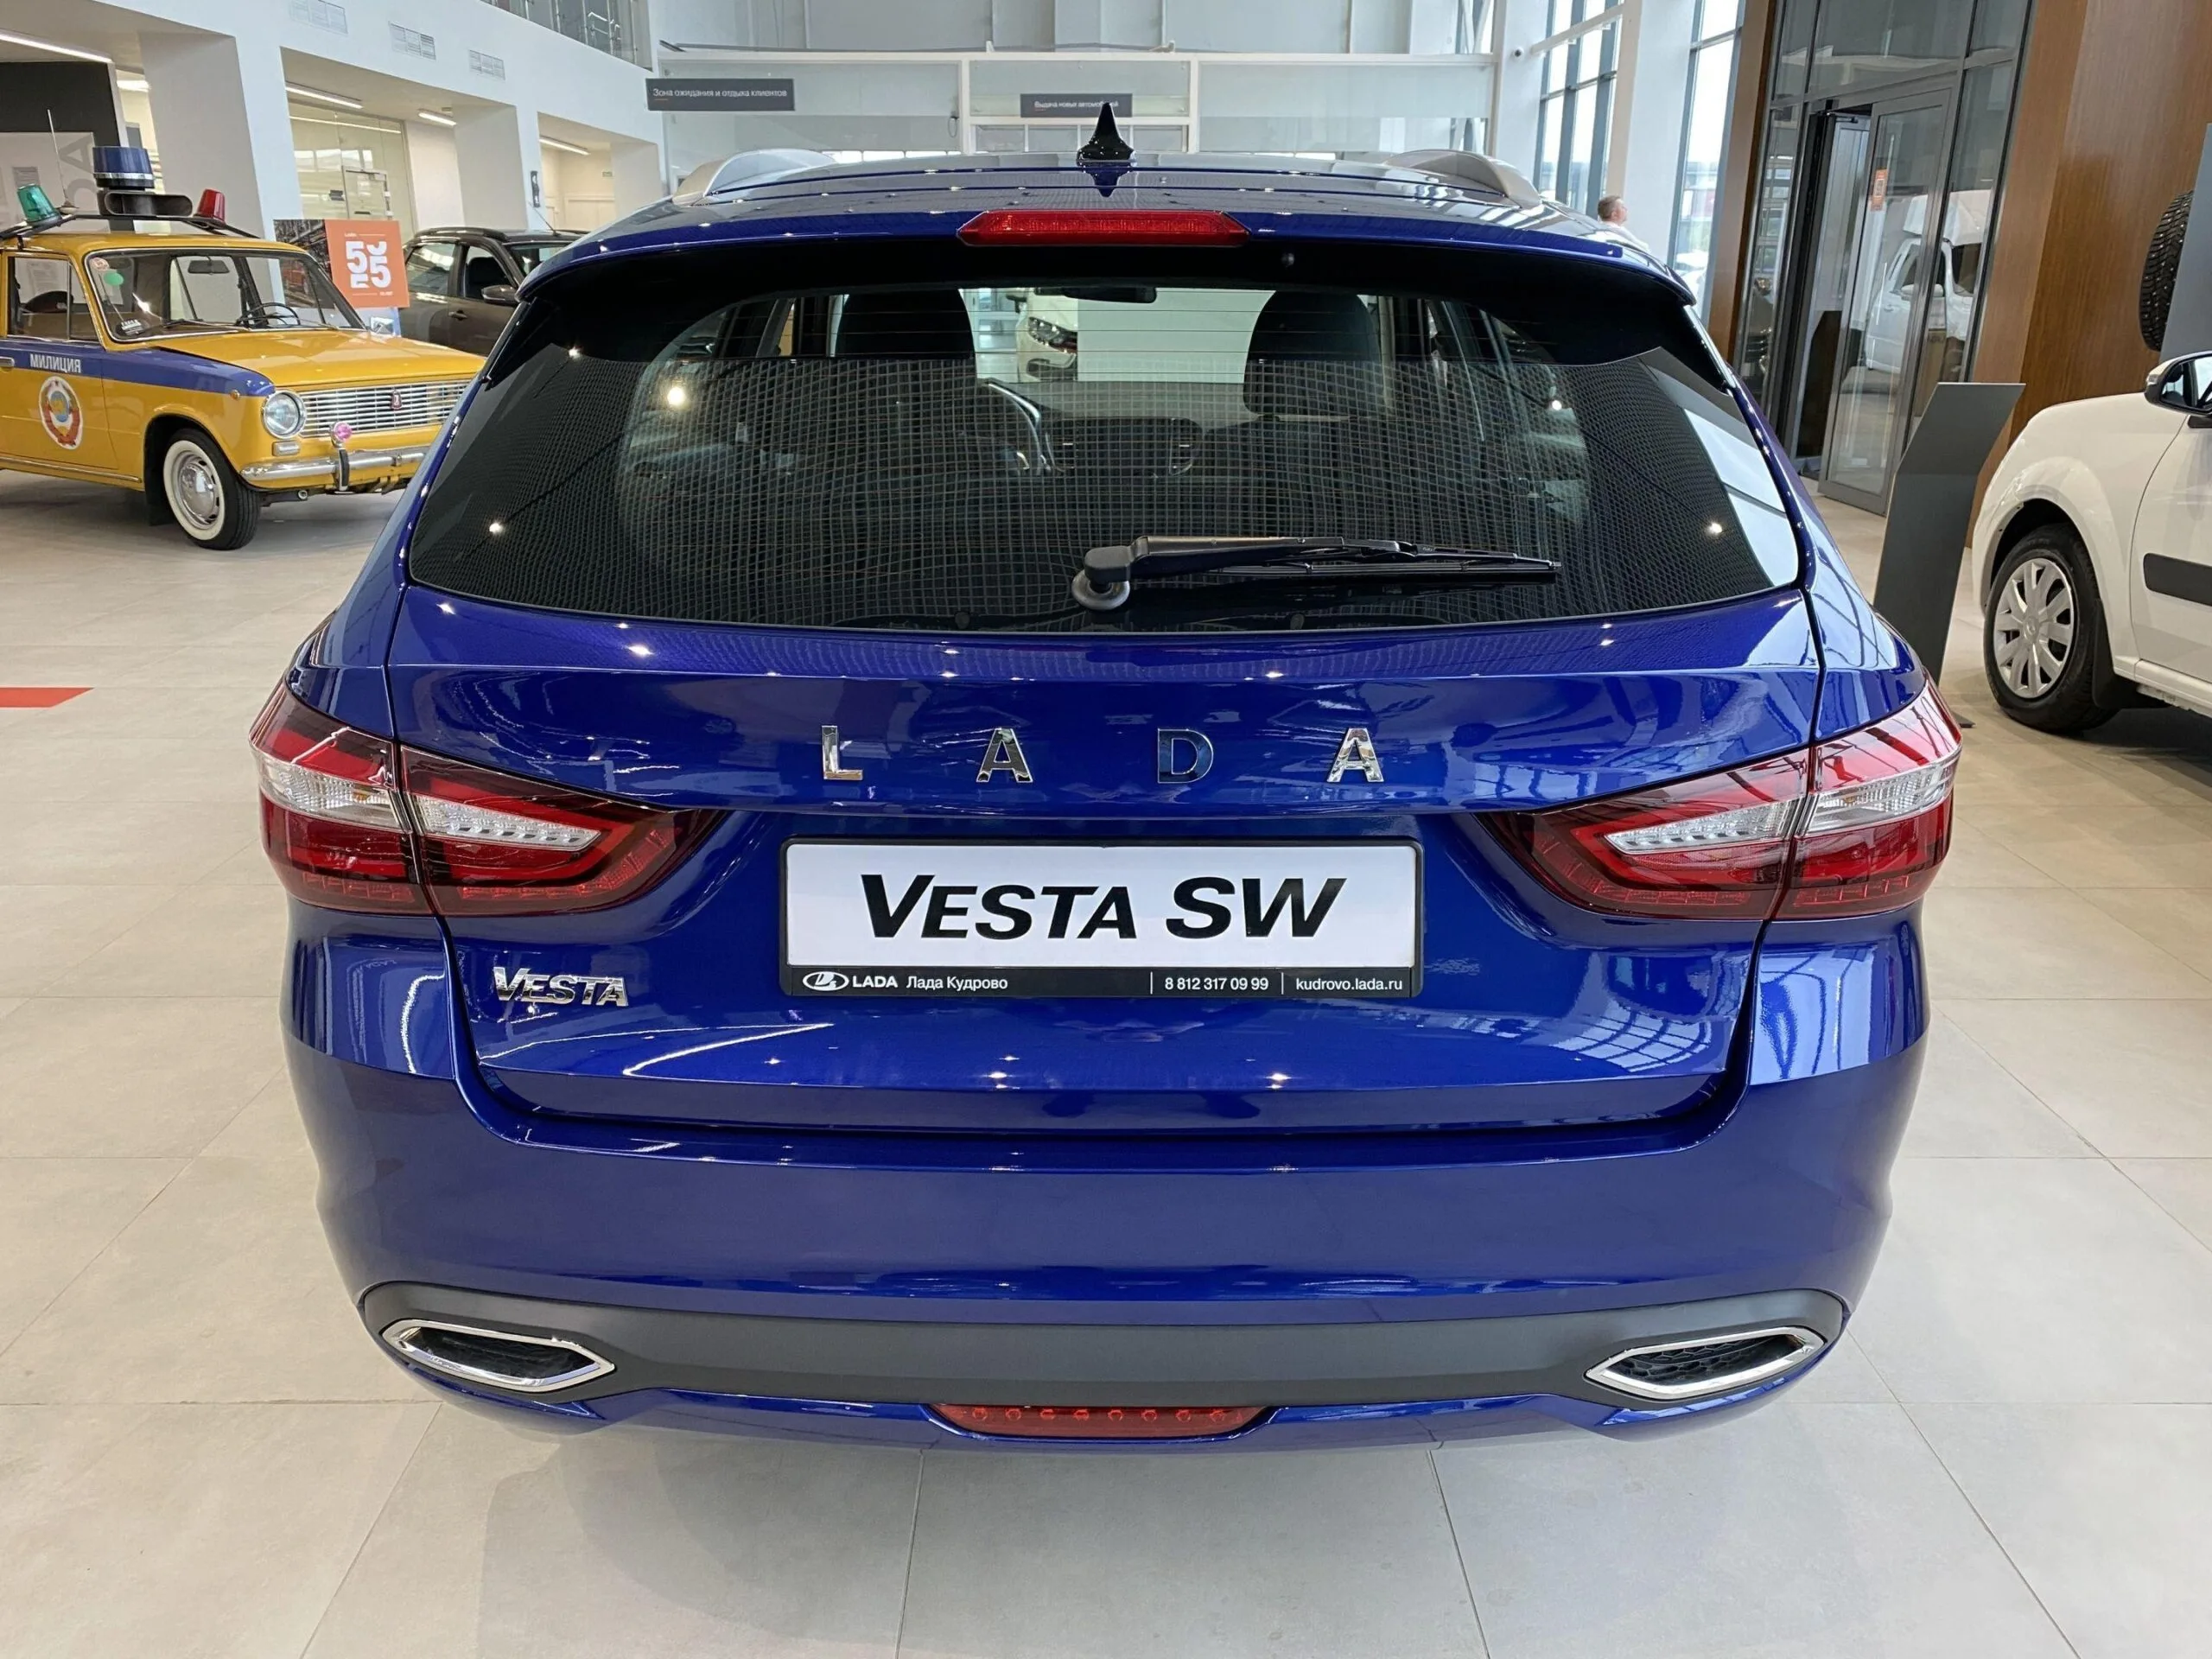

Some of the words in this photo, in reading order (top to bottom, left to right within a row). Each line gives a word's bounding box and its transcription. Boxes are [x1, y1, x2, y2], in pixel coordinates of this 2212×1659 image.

[653, 88, 673, 97] Зона
[29, 353, 81, 373] МИЛИЦИЯ
[821, 725, 1384, 783] LADA
[860, 874, 1137, 939] VESTA
[1166, 876, 1347, 939] SW
[493, 966, 629, 1007] VESTA
[852, 976, 898, 988] LADA
[906, 976, 943, 989] Лада
[947, 976, 1008, 992] Кудрово
[1165, 977, 1174, 990] 8
[1177, 977, 1201, 990] 812
[1204, 977, 1227, 990] 317
[1230, 977, 1248, 990] 09
[1251, 977, 1269, 990] 99
[1296, 977, 1402, 990] kudrovo.lada.ru
